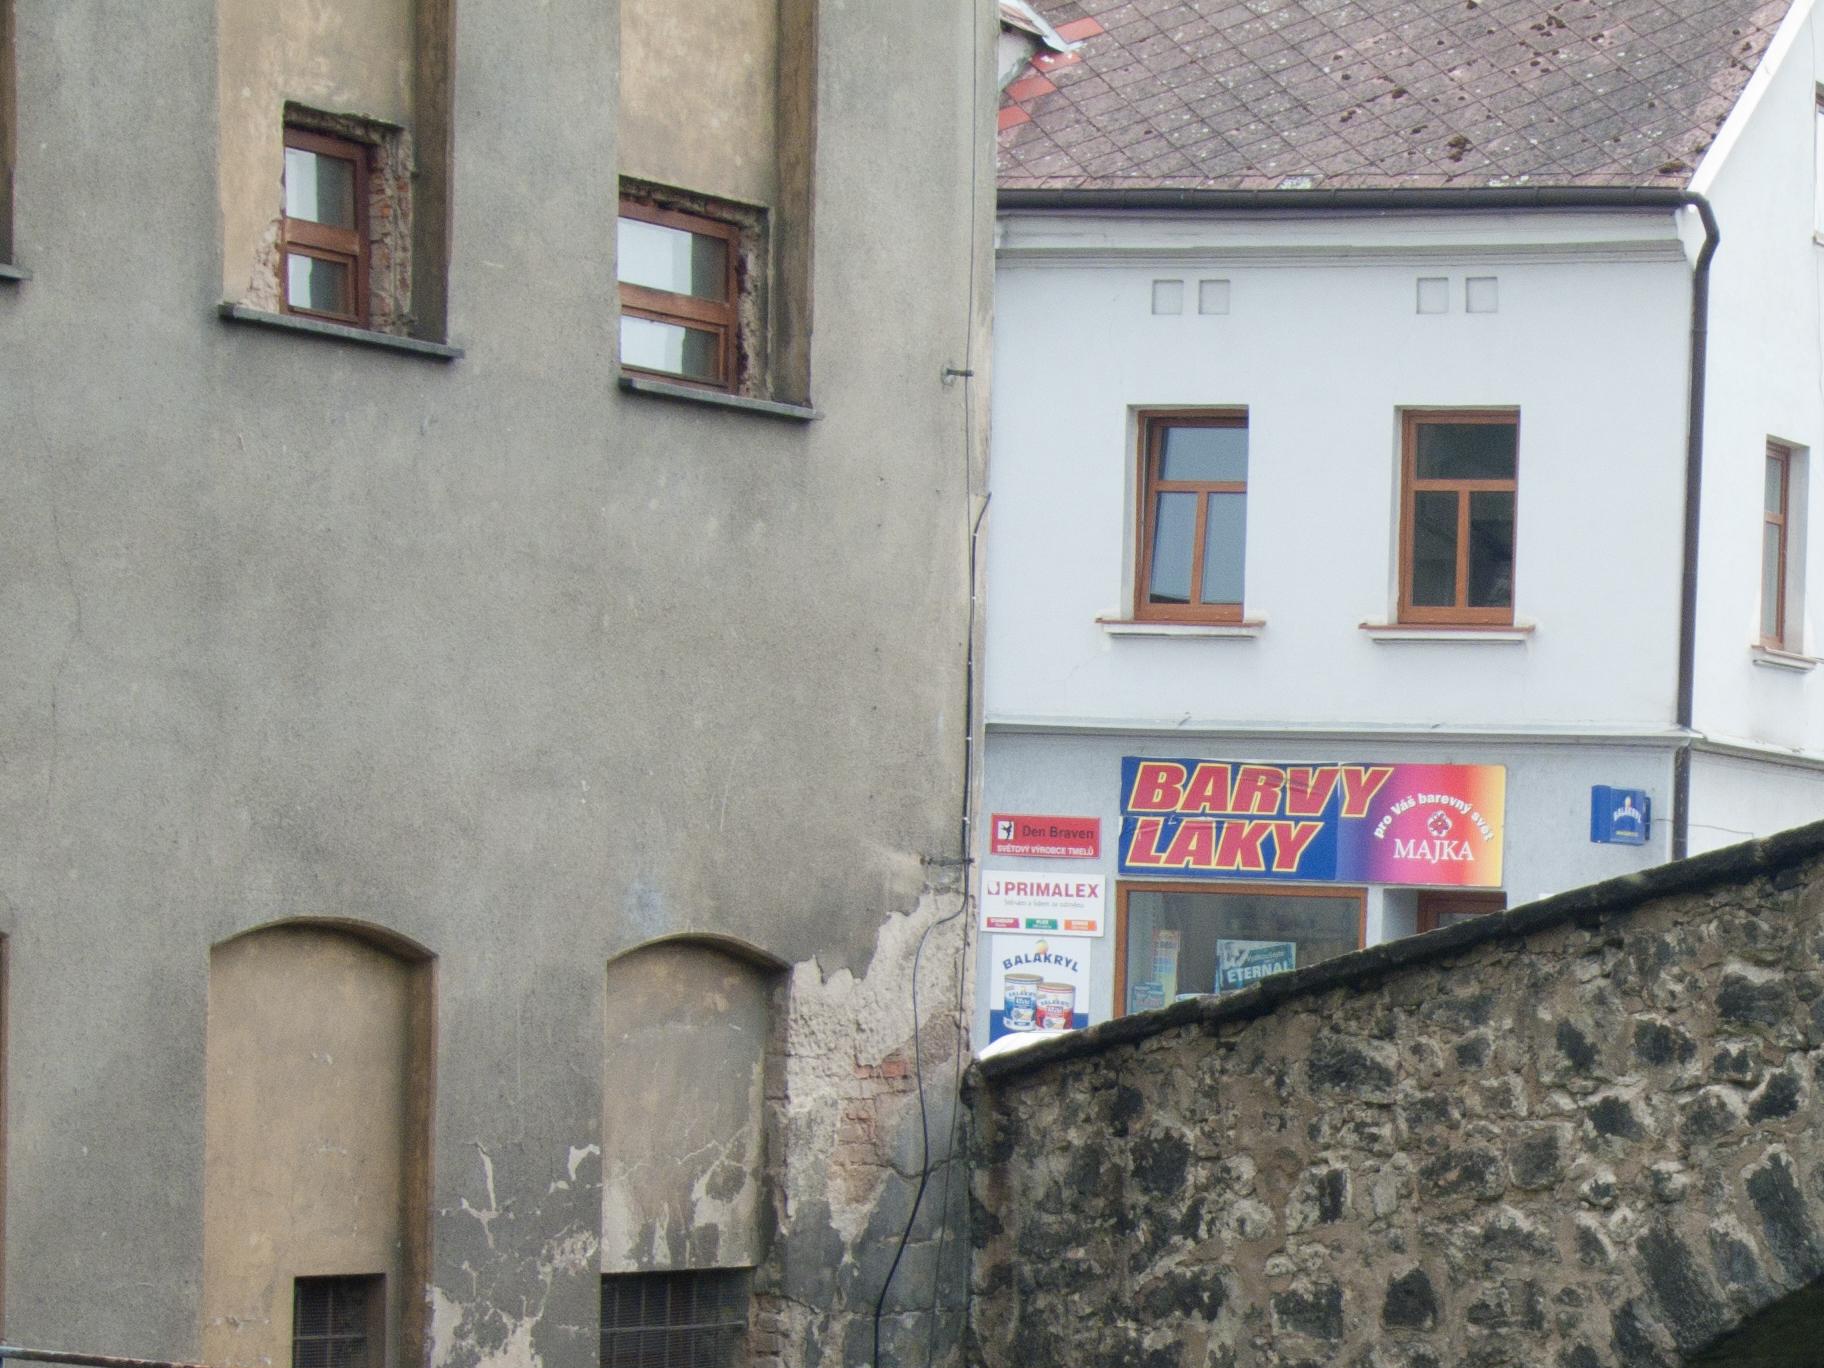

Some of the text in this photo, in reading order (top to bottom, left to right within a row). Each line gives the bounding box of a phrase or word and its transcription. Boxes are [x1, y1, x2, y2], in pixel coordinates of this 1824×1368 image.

[1127, 761, 1395, 818] BARVY
[1374, 815, 1393, 839] pro
[1390, 795, 1417, 815] Váš
[1418, 792, 1473, 815] barevný
[1023, 825, 1095, 839] Den Braven
[1125, 816, 1325, 872] LAKY
[1393, 838, 1475, 864] MAJKA
[1004, 881, 1100, 898] PRIMALEX
[1003, 952, 1079, 972] BALAKRYL
